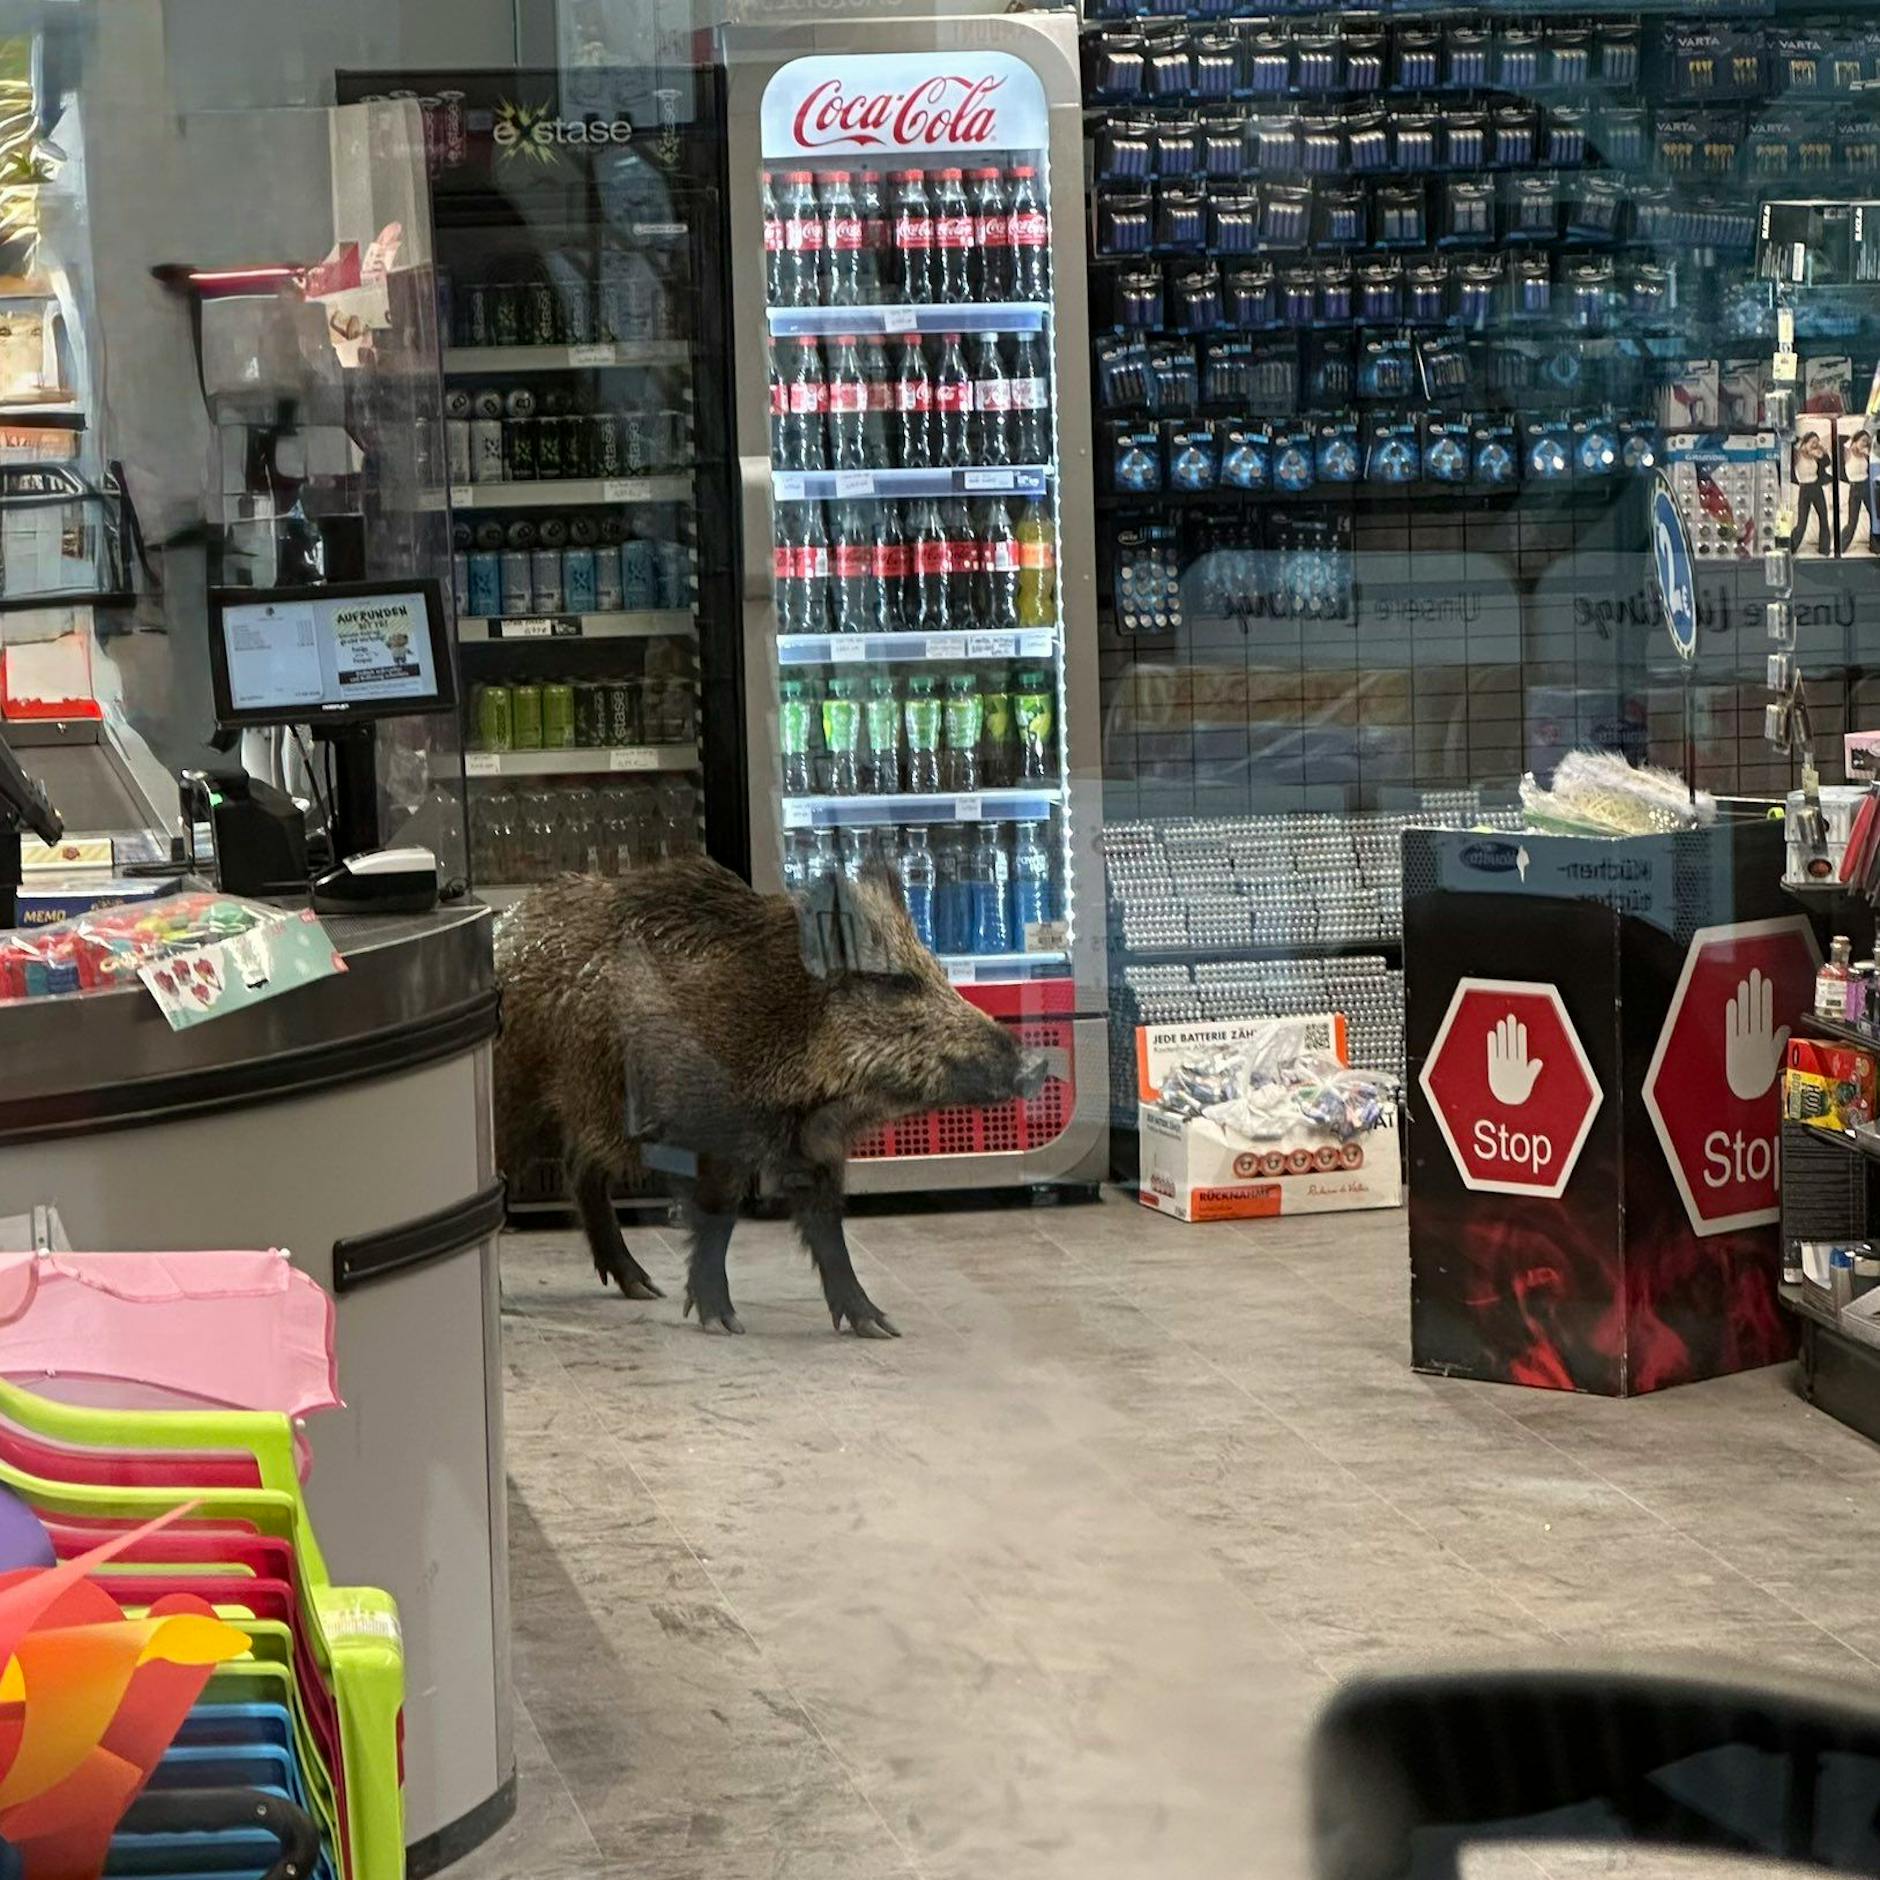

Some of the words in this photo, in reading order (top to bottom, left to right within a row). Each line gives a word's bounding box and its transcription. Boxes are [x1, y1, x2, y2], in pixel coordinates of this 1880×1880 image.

[1678, 36, 1720, 47] VARTA
[1779, 39, 1821, 50] VARTA
[793, 75, 1008, 148] Coca-Cola
[1657, 122, 1696, 132] VARTA
[1751, 123, 1791, 133] VARTA
[337, 605, 408, 624] AUFRUNDEN
[24, 910, 65, 924] MEMO
[1153, 1034, 1177, 1045] JEDE
[1181, 1030, 1227, 1043] BATTERIE
[1231, 1028, 1257, 1040] ZÄH
[1474, 1119, 1552, 1174] Stop
